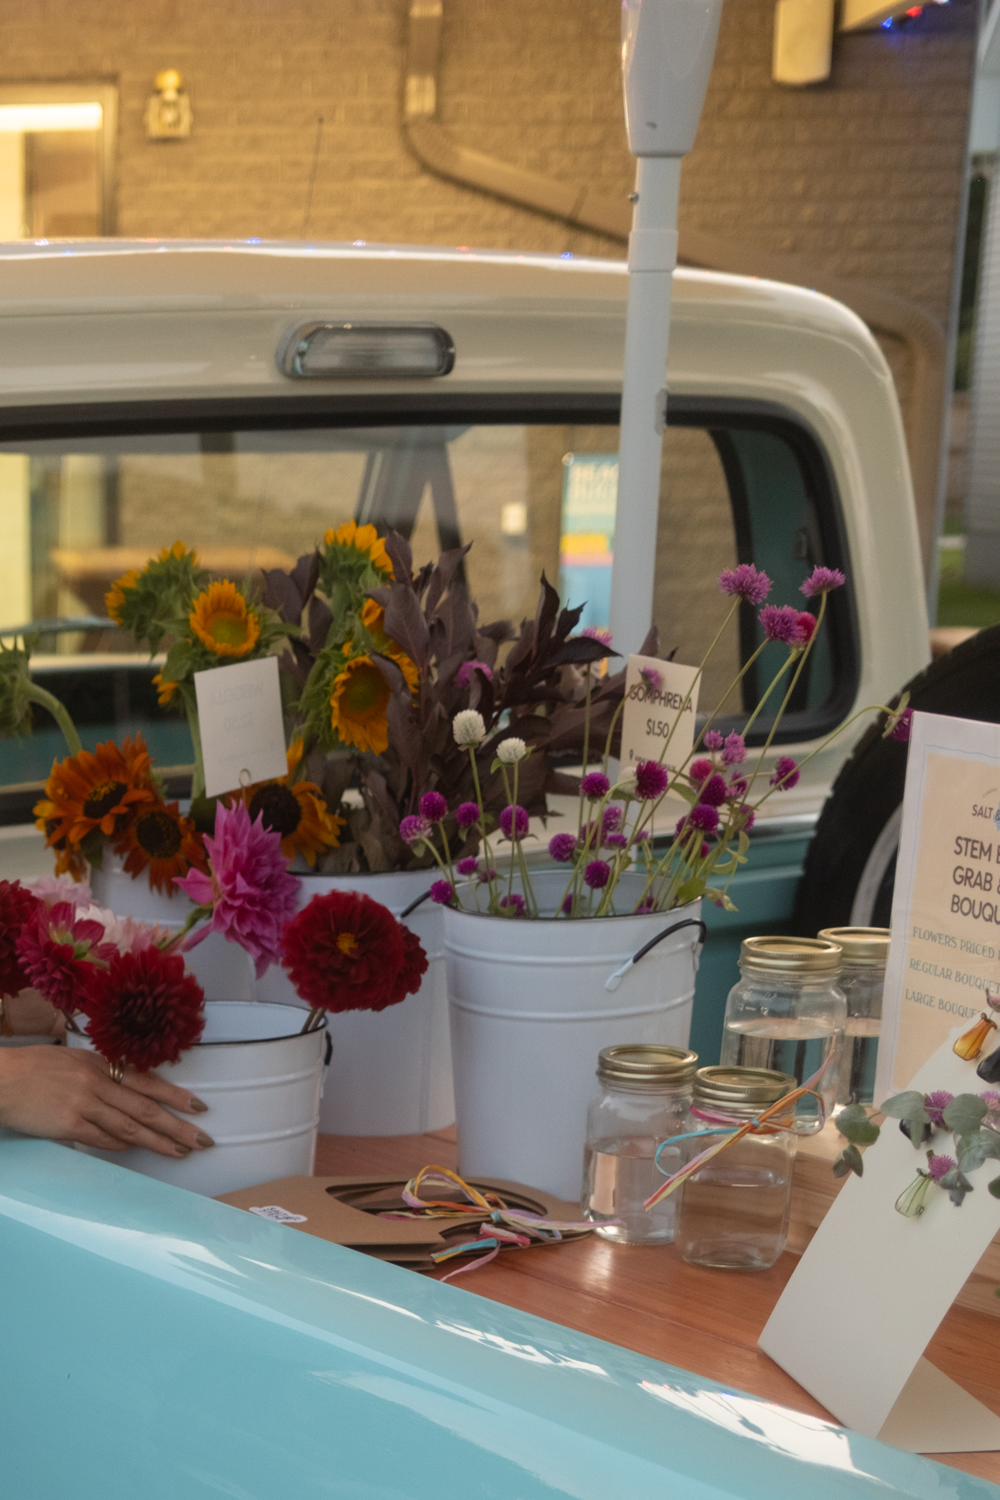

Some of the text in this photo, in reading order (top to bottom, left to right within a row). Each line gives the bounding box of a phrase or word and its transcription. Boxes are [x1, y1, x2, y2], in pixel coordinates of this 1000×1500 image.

[971, 803, 994, 820] SALT
[953, 835, 993, 863] STEM
[952, 865, 993, 893] GRAB
[912, 926, 958, 949] FLOWERS
[959, 938, 995, 959] PRICED
[909, 957, 953, 981] REGULAR
[904, 988, 982, 1020] LARGE BOUQUE
